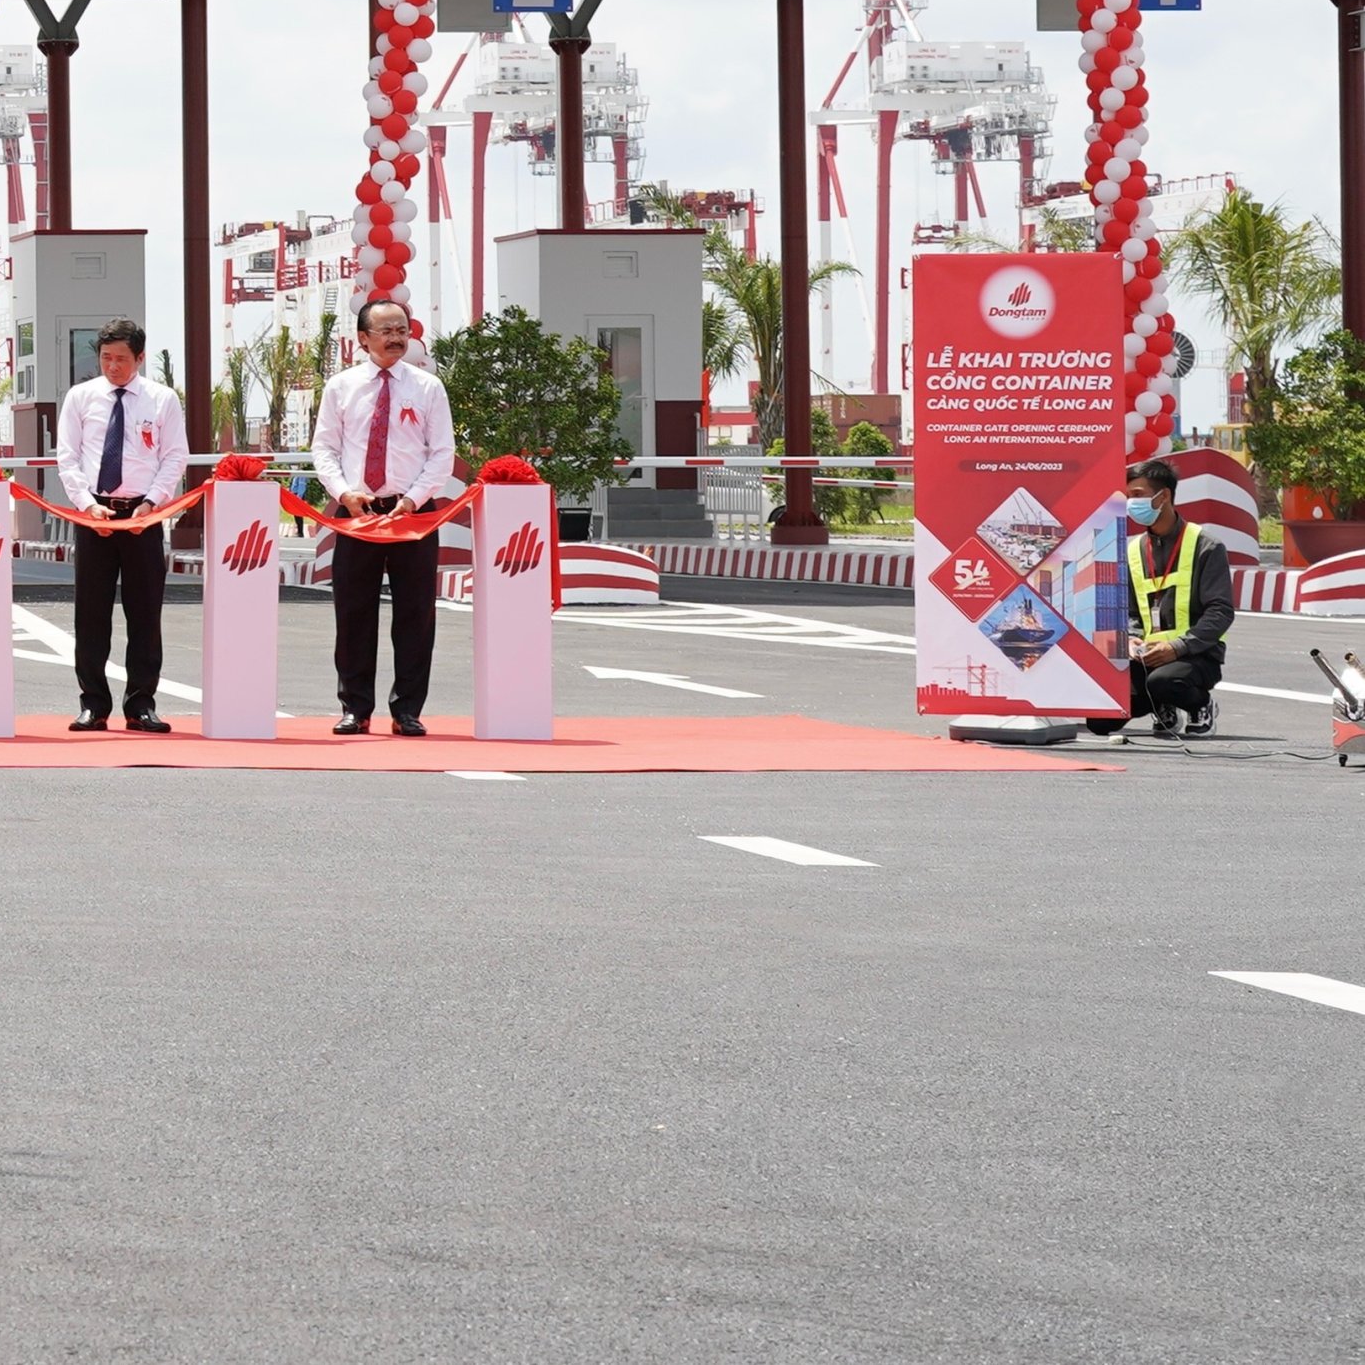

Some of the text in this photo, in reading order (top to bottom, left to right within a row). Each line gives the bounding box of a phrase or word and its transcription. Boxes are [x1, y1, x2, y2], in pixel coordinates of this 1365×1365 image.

[989, 307, 1046, 319] Dongtam
[926, 346, 1112, 368] LỄ KHAI TRƯƠNG
[991, 375, 1113, 390] CONTAINER
[926, 394, 1113, 411] CẢNG QUỐC TẾ LONG AN
[926, 424, 1113, 432] CONTAINER GATE OPENING CEREMONY
[944, 435, 971, 443] LONG
[989, 436, 1066, 444] INTERNATIONAL
[1068, 436, 1095, 444] PORT
[975, 462, 997, 471] Long
[954, 559, 990, 584] 54
